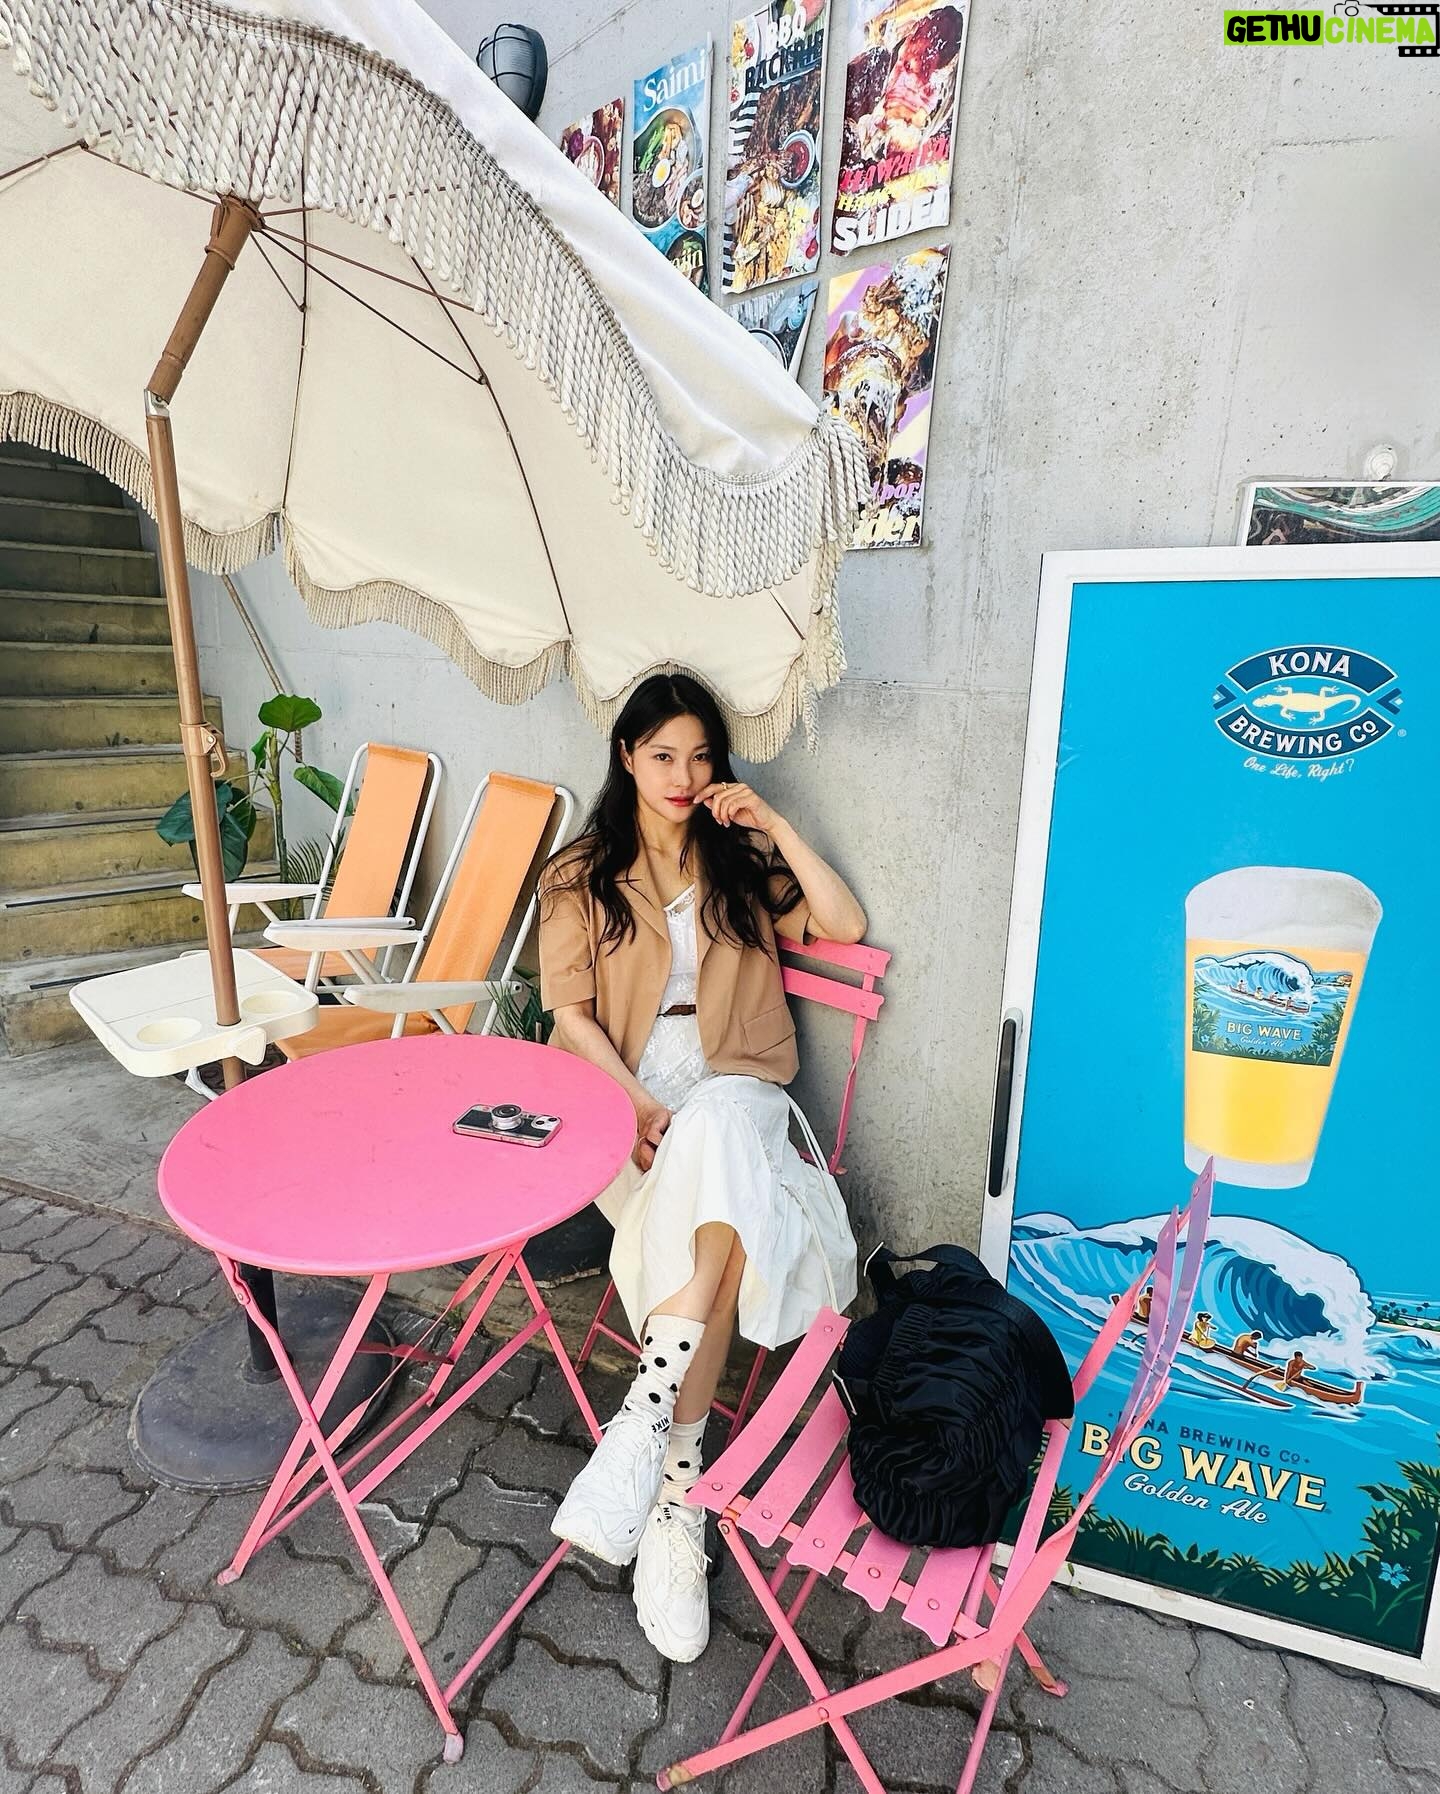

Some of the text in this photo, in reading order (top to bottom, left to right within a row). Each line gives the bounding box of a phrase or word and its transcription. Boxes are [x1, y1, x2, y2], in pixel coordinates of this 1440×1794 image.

[767, 6, 807, 57] BBQ
[1268, 651, 1351, 678] KONA
[1228, 714, 1343, 755] BREWING
[1243, 756, 1267, 773] One
[1307, 758, 1355, 783] Right?
[1226, 1021, 1303, 1041] BIG WAVE
[651, 1415, 670, 1434] NIKE
[1180, 1426, 1271, 1459] BREWING
[1081, 1421, 1329, 1512] BG WAVE
[1123, 1472, 1269, 1525] Golden Ale
